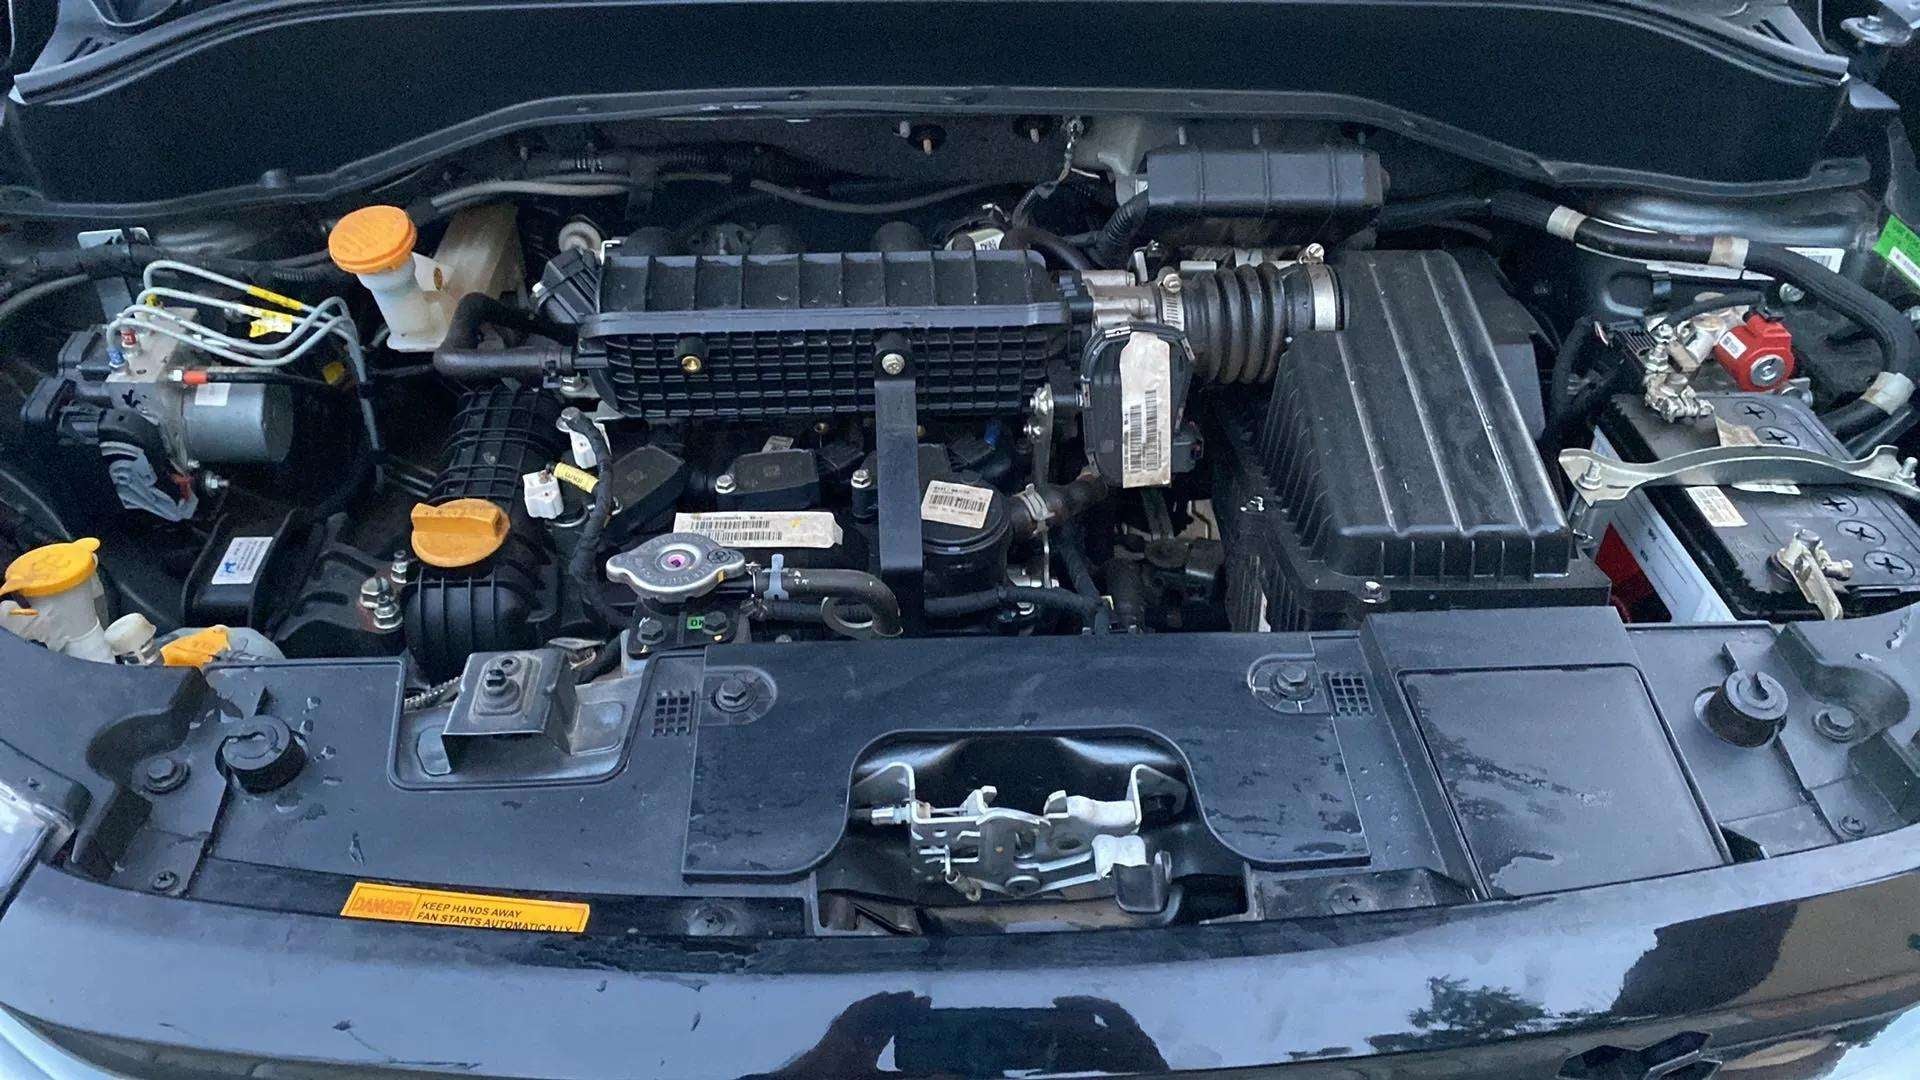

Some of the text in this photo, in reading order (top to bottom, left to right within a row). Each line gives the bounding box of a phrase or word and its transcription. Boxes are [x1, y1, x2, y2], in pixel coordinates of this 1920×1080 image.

[352, 896, 413, 916] DANGER
[421, 901, 522, 919] KEEP HANDS AWAY
[416, 911, 439, 921] FAN
[441, 914, 481, 926] STARTS
